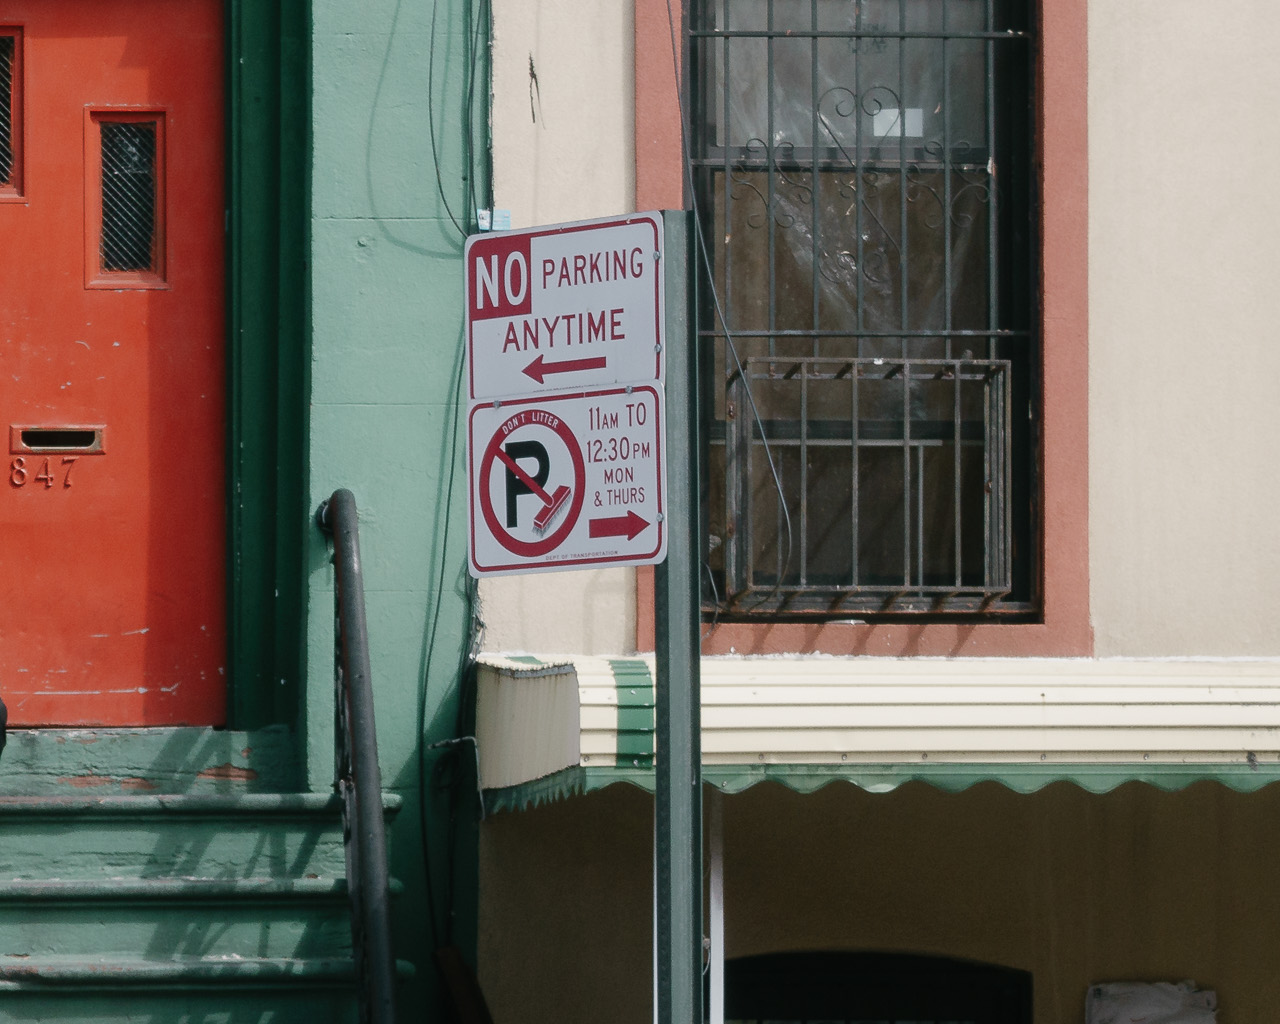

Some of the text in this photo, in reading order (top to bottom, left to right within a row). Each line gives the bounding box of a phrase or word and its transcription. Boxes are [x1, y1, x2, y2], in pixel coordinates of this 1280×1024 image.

[475, 247, 644, 310] NO PARKING
[502, 307, 626, 354] ANYTIME
[501, 411, 559, 435] DON'T LITTER
[625, 401, 647, 429] TO
[8, 456, 80, 490] 847
[603, 466, 635, 484] MON
[593, 486, 646, 507] & THURS
[570, 550, 619, 559] TRANSPORTATION
